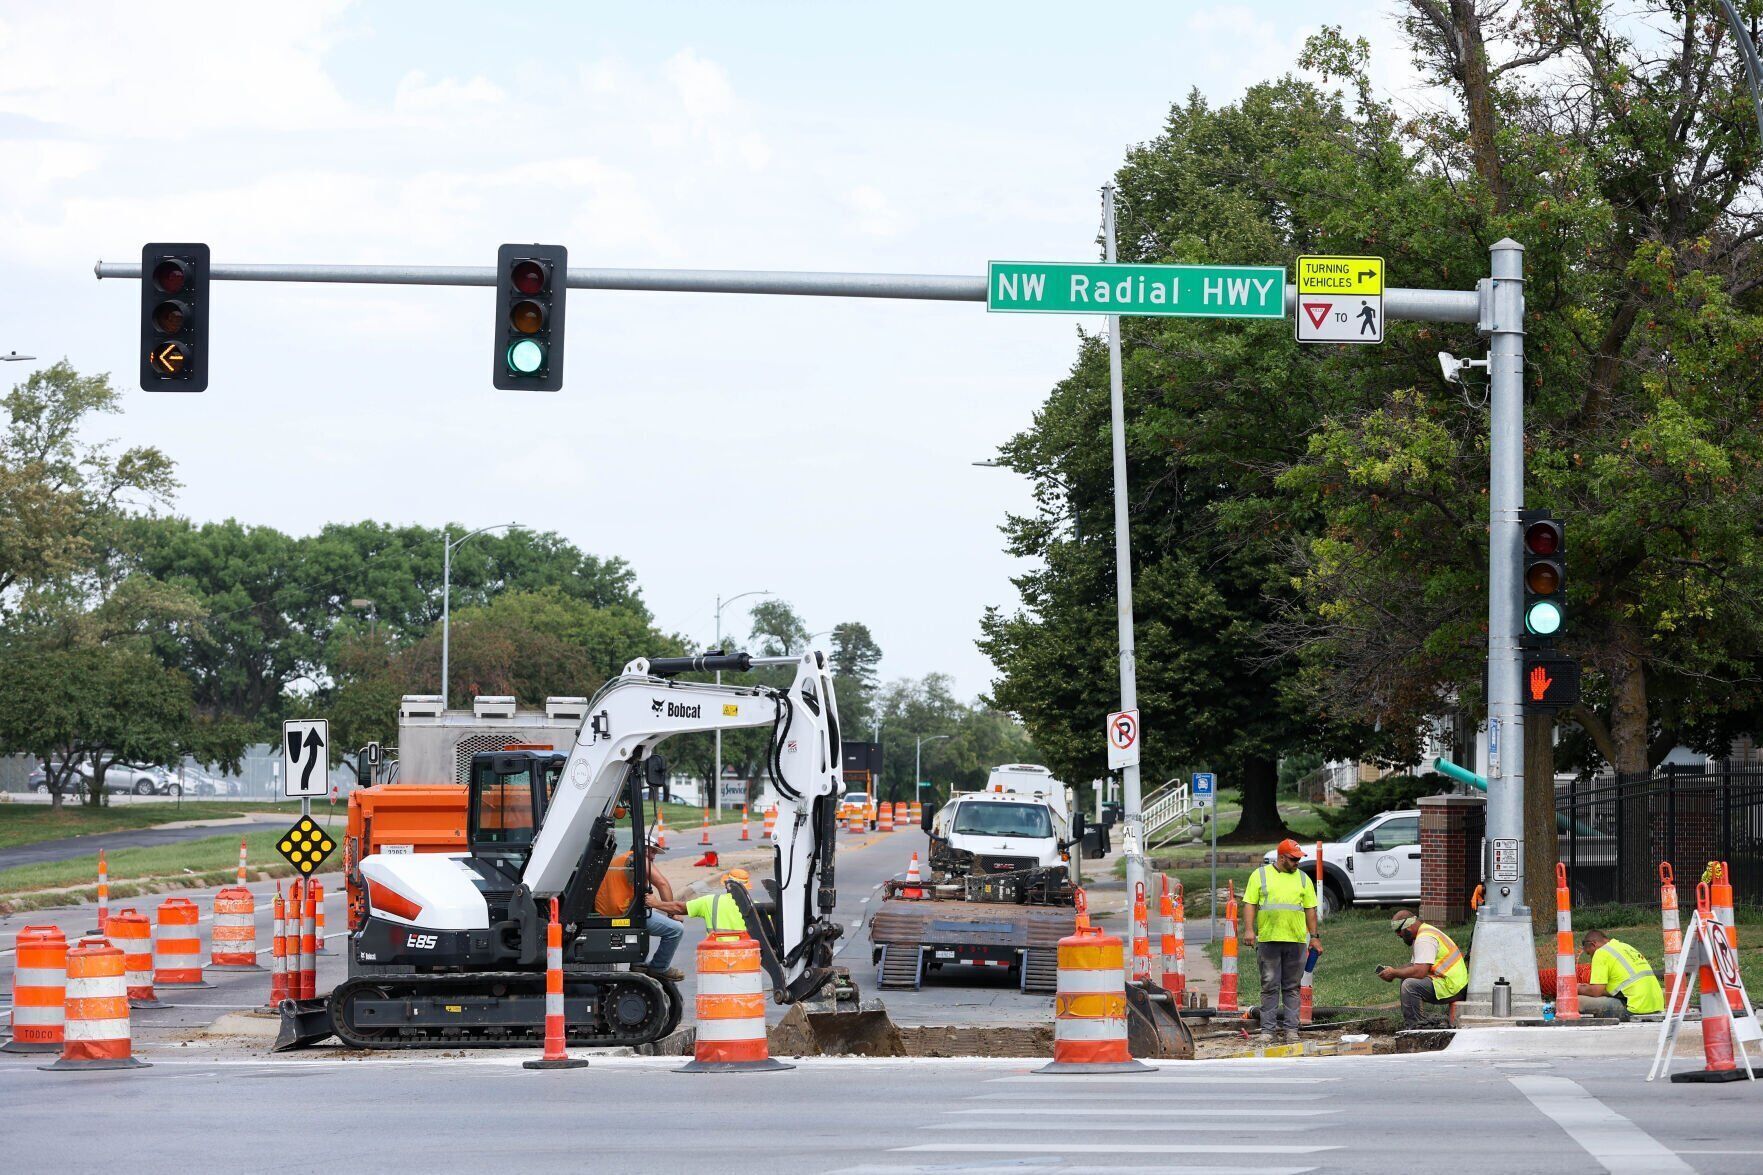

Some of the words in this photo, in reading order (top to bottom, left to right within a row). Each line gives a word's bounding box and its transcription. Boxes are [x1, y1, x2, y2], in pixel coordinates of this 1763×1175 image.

[1305, 263, 1350, 274] TURNING
[998, 273, 1046, 302] NW
[1070, 274, 1179, 304] Radial
[1203, 277, 1275, 306] HWY
[1303, 277, 1352, 288] VEHICLES
[1335, 313, 1348, 322] TO
[667, 701, 701, 719] Bobcat
[406, 933, 438, 950] E85
